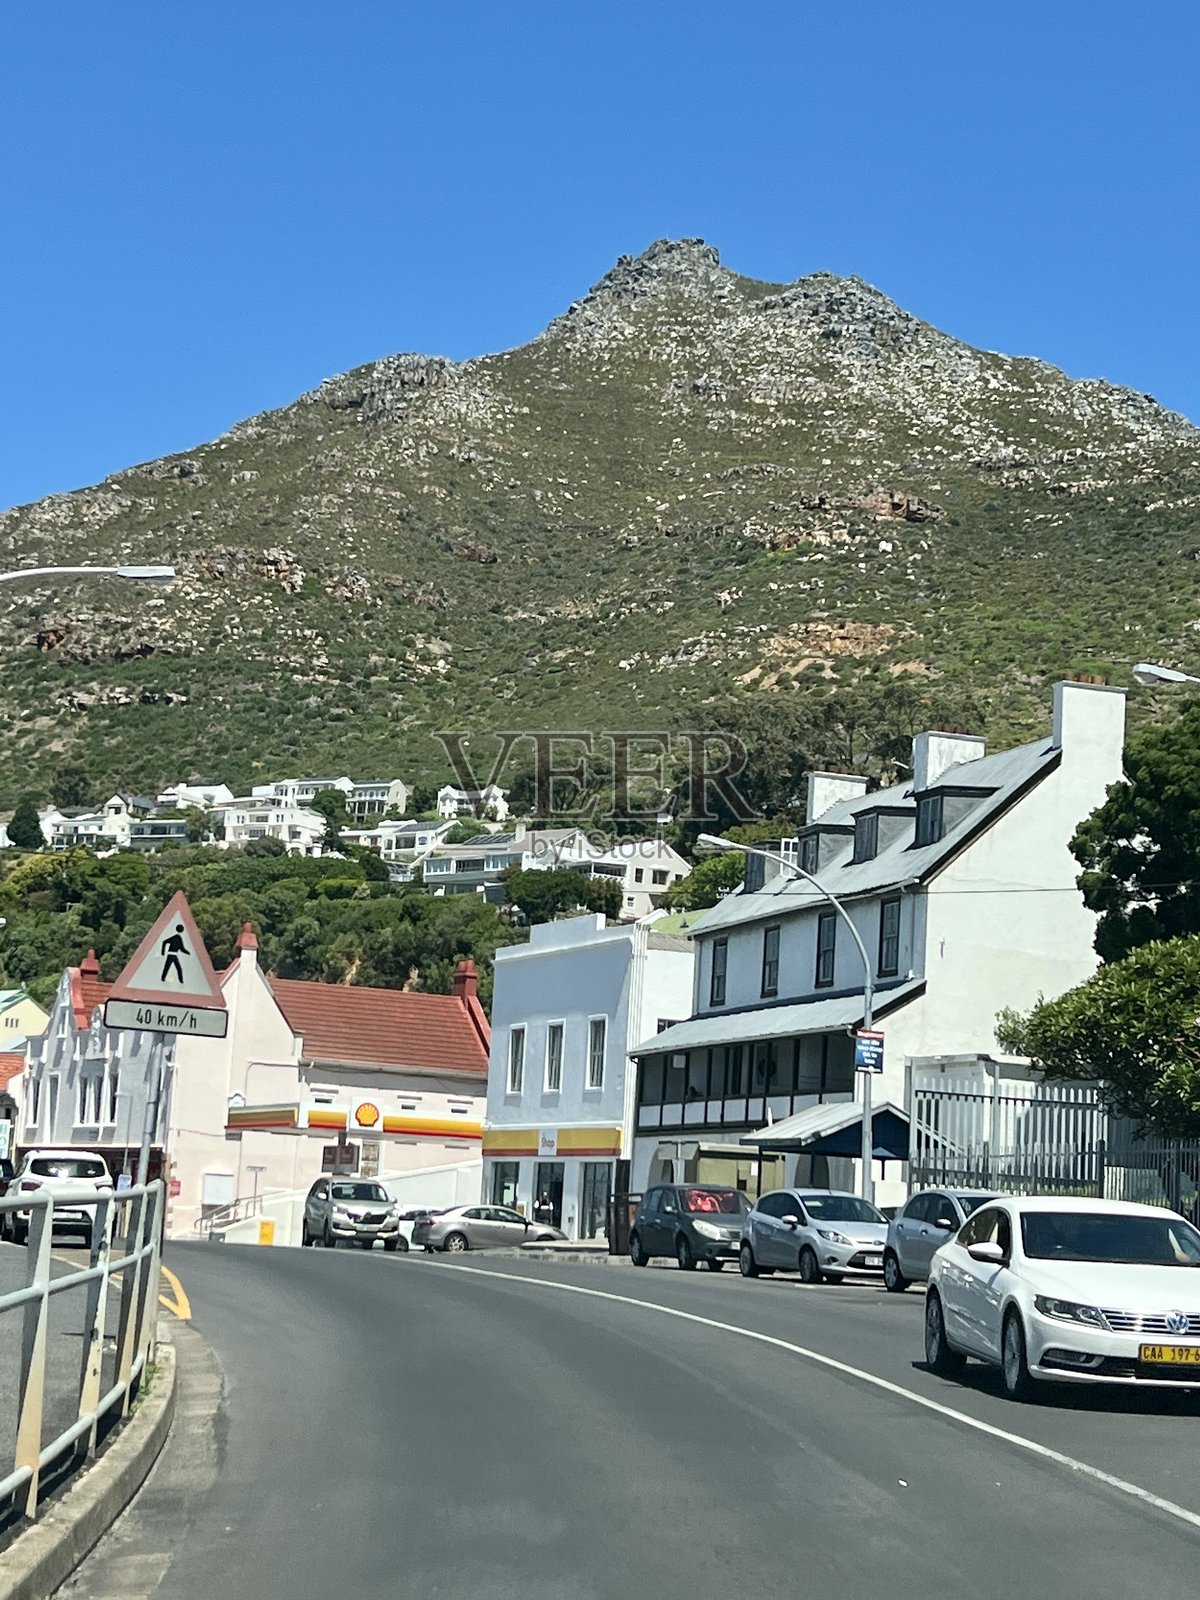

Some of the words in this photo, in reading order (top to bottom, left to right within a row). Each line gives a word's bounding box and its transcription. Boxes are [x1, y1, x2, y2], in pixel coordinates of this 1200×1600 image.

[136, 1008, 152, 1025] 40
[157, 1010, 198, 1029] km/h
[1143, 1346, 1164, 1360] CAA
